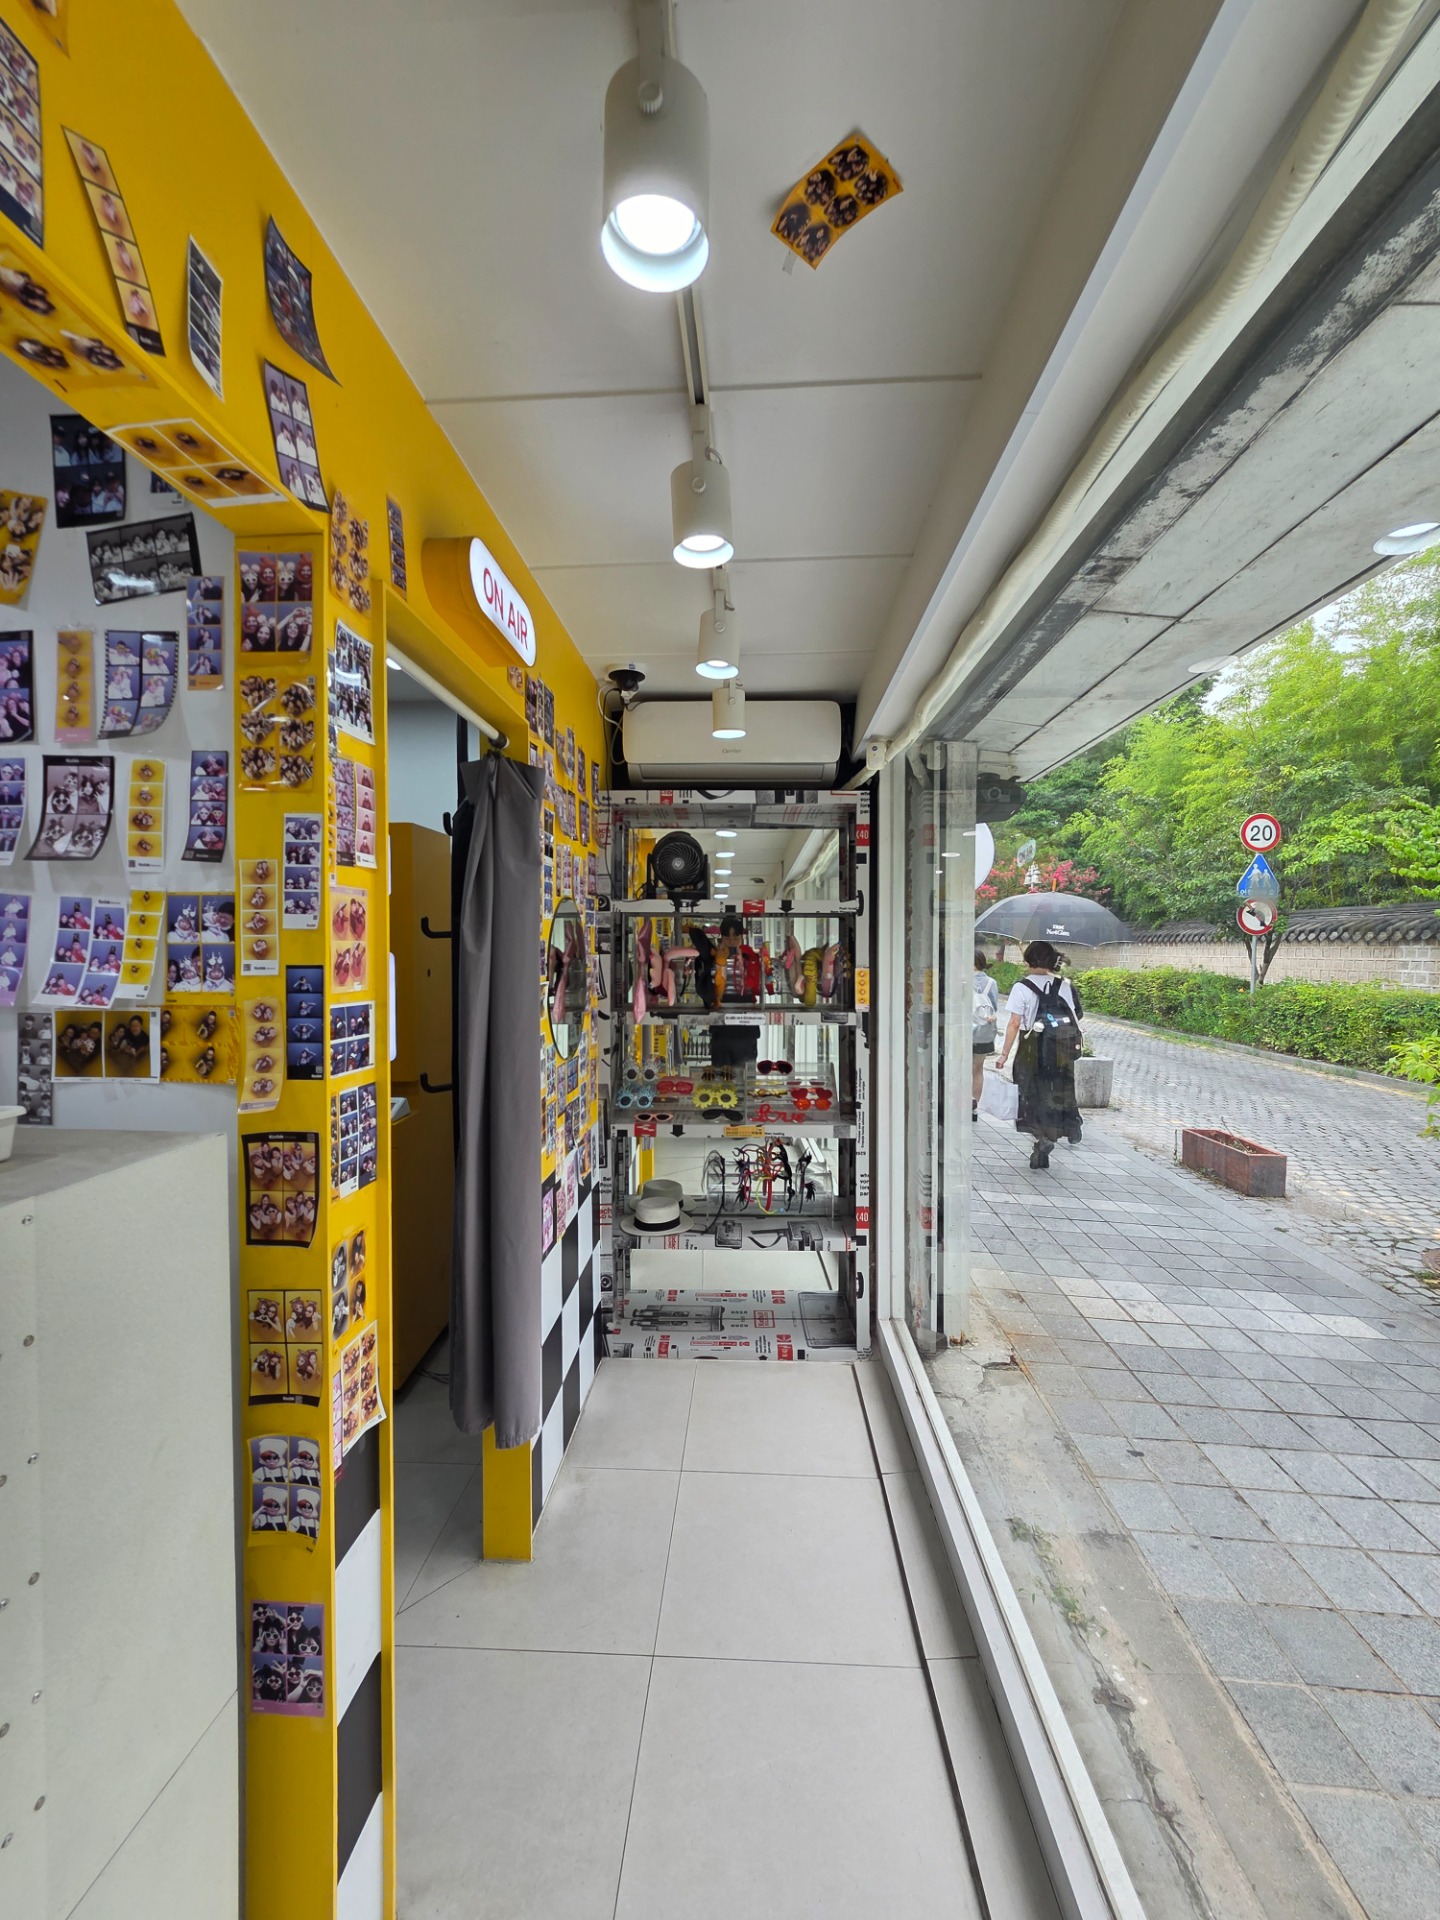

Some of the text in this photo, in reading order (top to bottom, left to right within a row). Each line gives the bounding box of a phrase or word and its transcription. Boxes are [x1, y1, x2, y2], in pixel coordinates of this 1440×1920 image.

[483, 567, 529, 650] ON AIR
[1250, 825, 1273, 842] 20
